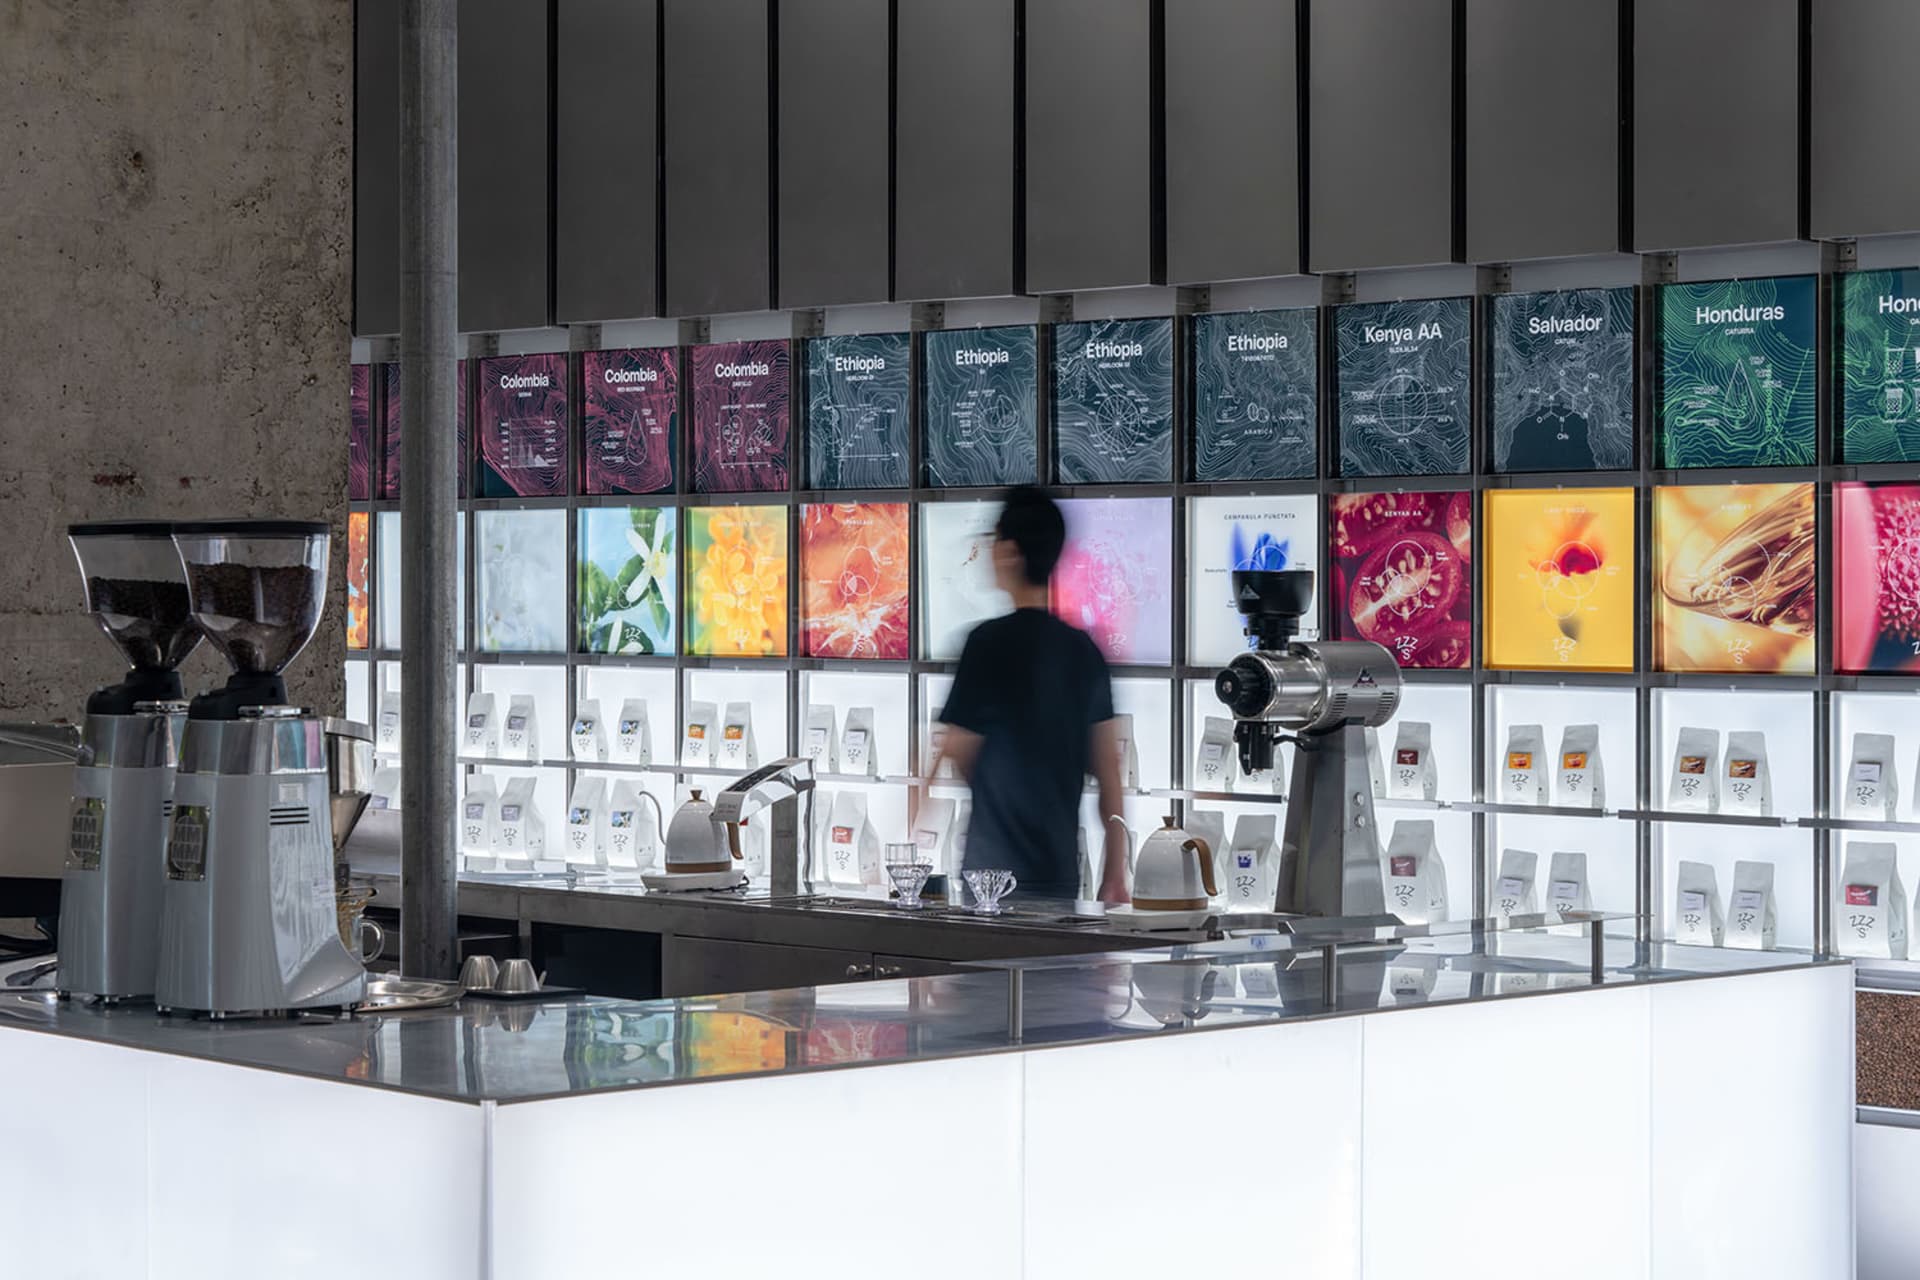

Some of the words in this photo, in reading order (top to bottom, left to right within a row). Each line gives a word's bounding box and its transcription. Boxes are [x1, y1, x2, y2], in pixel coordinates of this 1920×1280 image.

[1528, 314, 1603, 335] Salvador
[1696, 304, 1785, 325] Honduras
[1228, 332, 1288, 353] Ethiopia
[1365, 326, 1413, 346] Kenya
[1417, 322, 1443, 341] AA
[955, 347, 1009, 367] Ethiopia
[1086, 340, 1142, 361] Ethiopia
[714, 361, 769, 378] Colombia
[835, 354, 885, 374] Ethiopia
[500, 373, 549, 389] Colombia
[604, 367, 657, 384] Colombia
[1224, 513, 1261, 521] CAMPANULA
[1264, 512, 1296, 520] PUNCTATA
[1394, 636, 1418, 650] ZZZ
[1849, 914, 1875, 929] ZZZ
